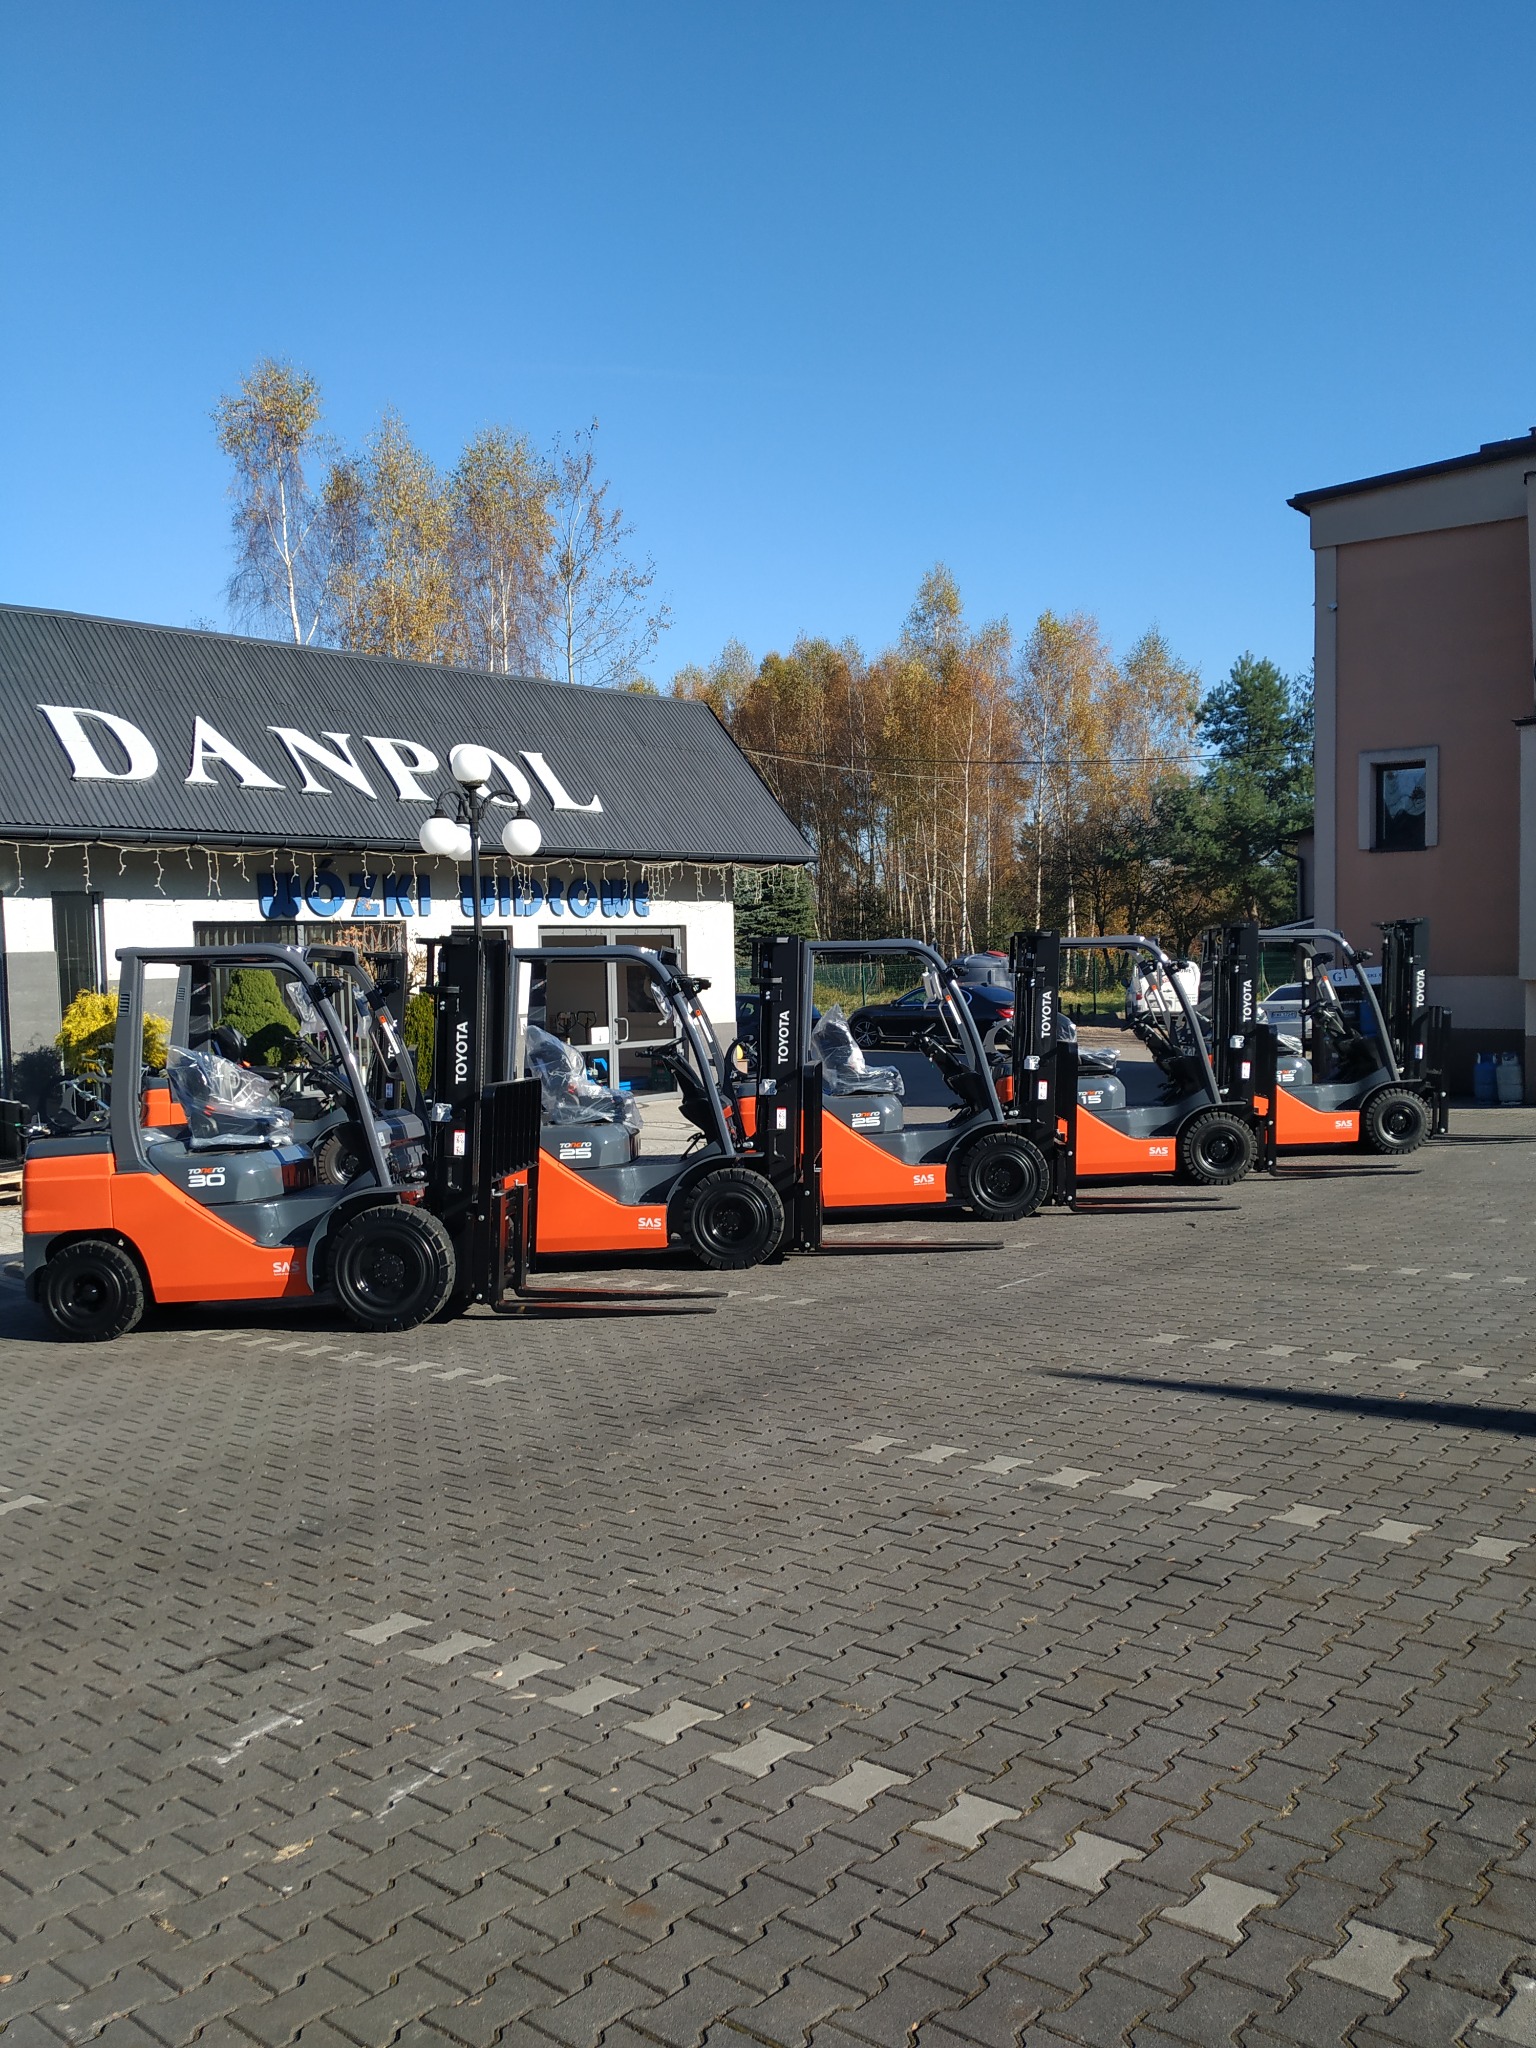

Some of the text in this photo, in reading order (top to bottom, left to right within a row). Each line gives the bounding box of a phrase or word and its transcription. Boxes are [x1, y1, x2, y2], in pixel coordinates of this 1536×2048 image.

[37, 704, 604, 813] DANPOL
[257, 858, 431, 919] WÓZKI
[1416, 969, 1426, 1008] TOYOTA
[1243, 979, 1252, 1022] TOYOTA
[1041, 990, 1052, 1039] TOYOTA
[778, 1010, 790, 1065] TOYOTA
[455, 1021, 469, 1085] TOYOTA
[1081, 1095, 1102, 1105] 15
[852, 1117, 881, 1128] 25
[1335, 1119, 1353, 1127] SAS
[559, 1148, 592, 1160] 25
[1149, 1146, 1169, 1155] SAS
[188, 1173, 226, 1188] 30
[913, 1173, 935, 1184] SAS
[638, 1217, 662, 1227] SAS
[272, 1261, 300, 1273] SAS
